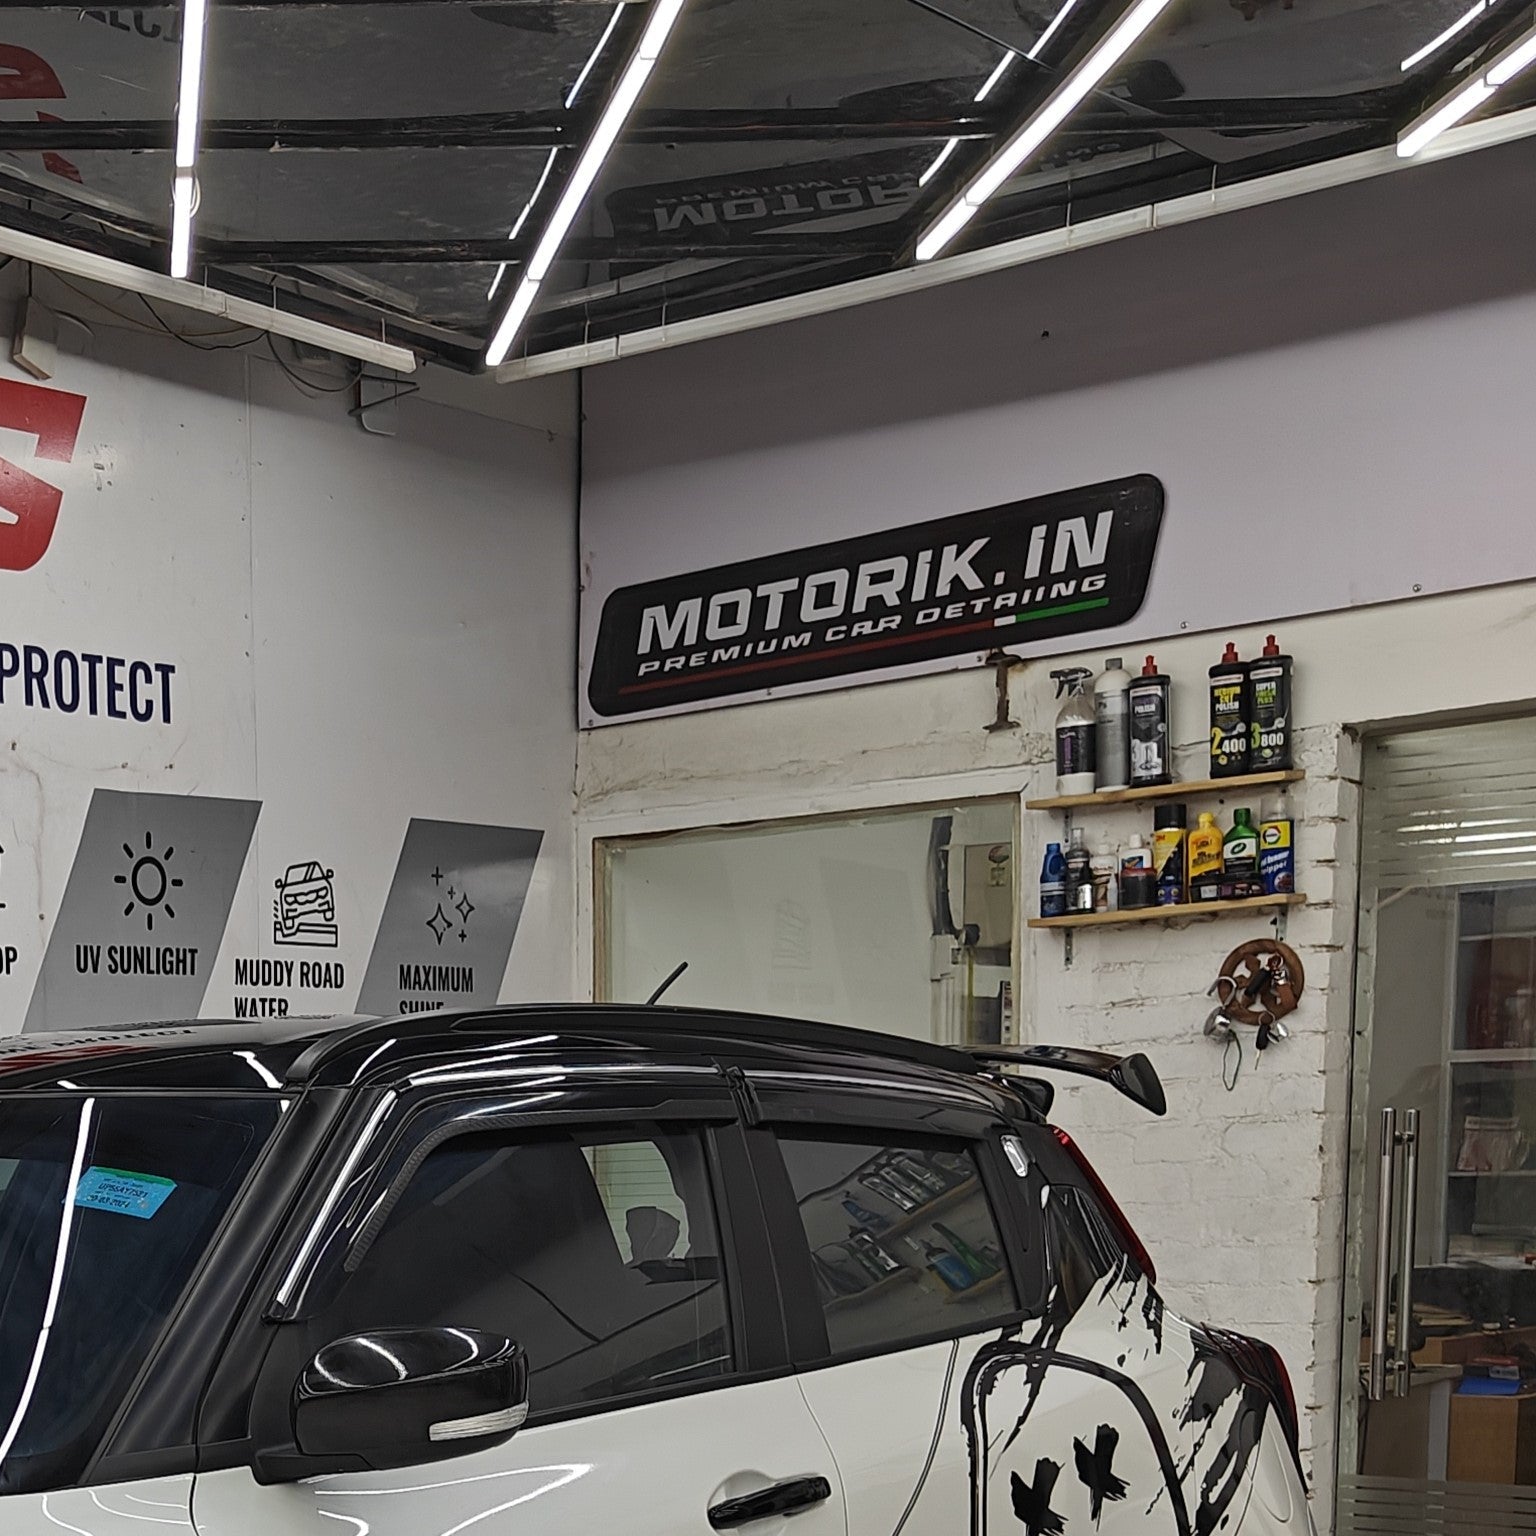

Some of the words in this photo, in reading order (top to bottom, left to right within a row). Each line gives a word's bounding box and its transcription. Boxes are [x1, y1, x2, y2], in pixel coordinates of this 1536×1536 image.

[637, 632, 812, 677] PREMIUM
[825, 613, 902, 643] CAR
[75, 945, 101, 974] UV
[107, 947, 198, 977] SUNLIGHT
[235, 959, 294, 989] MUDDY
[299, 960, 345, 990] ROAD
[399, 965, 474, 993] MAXIMUM
